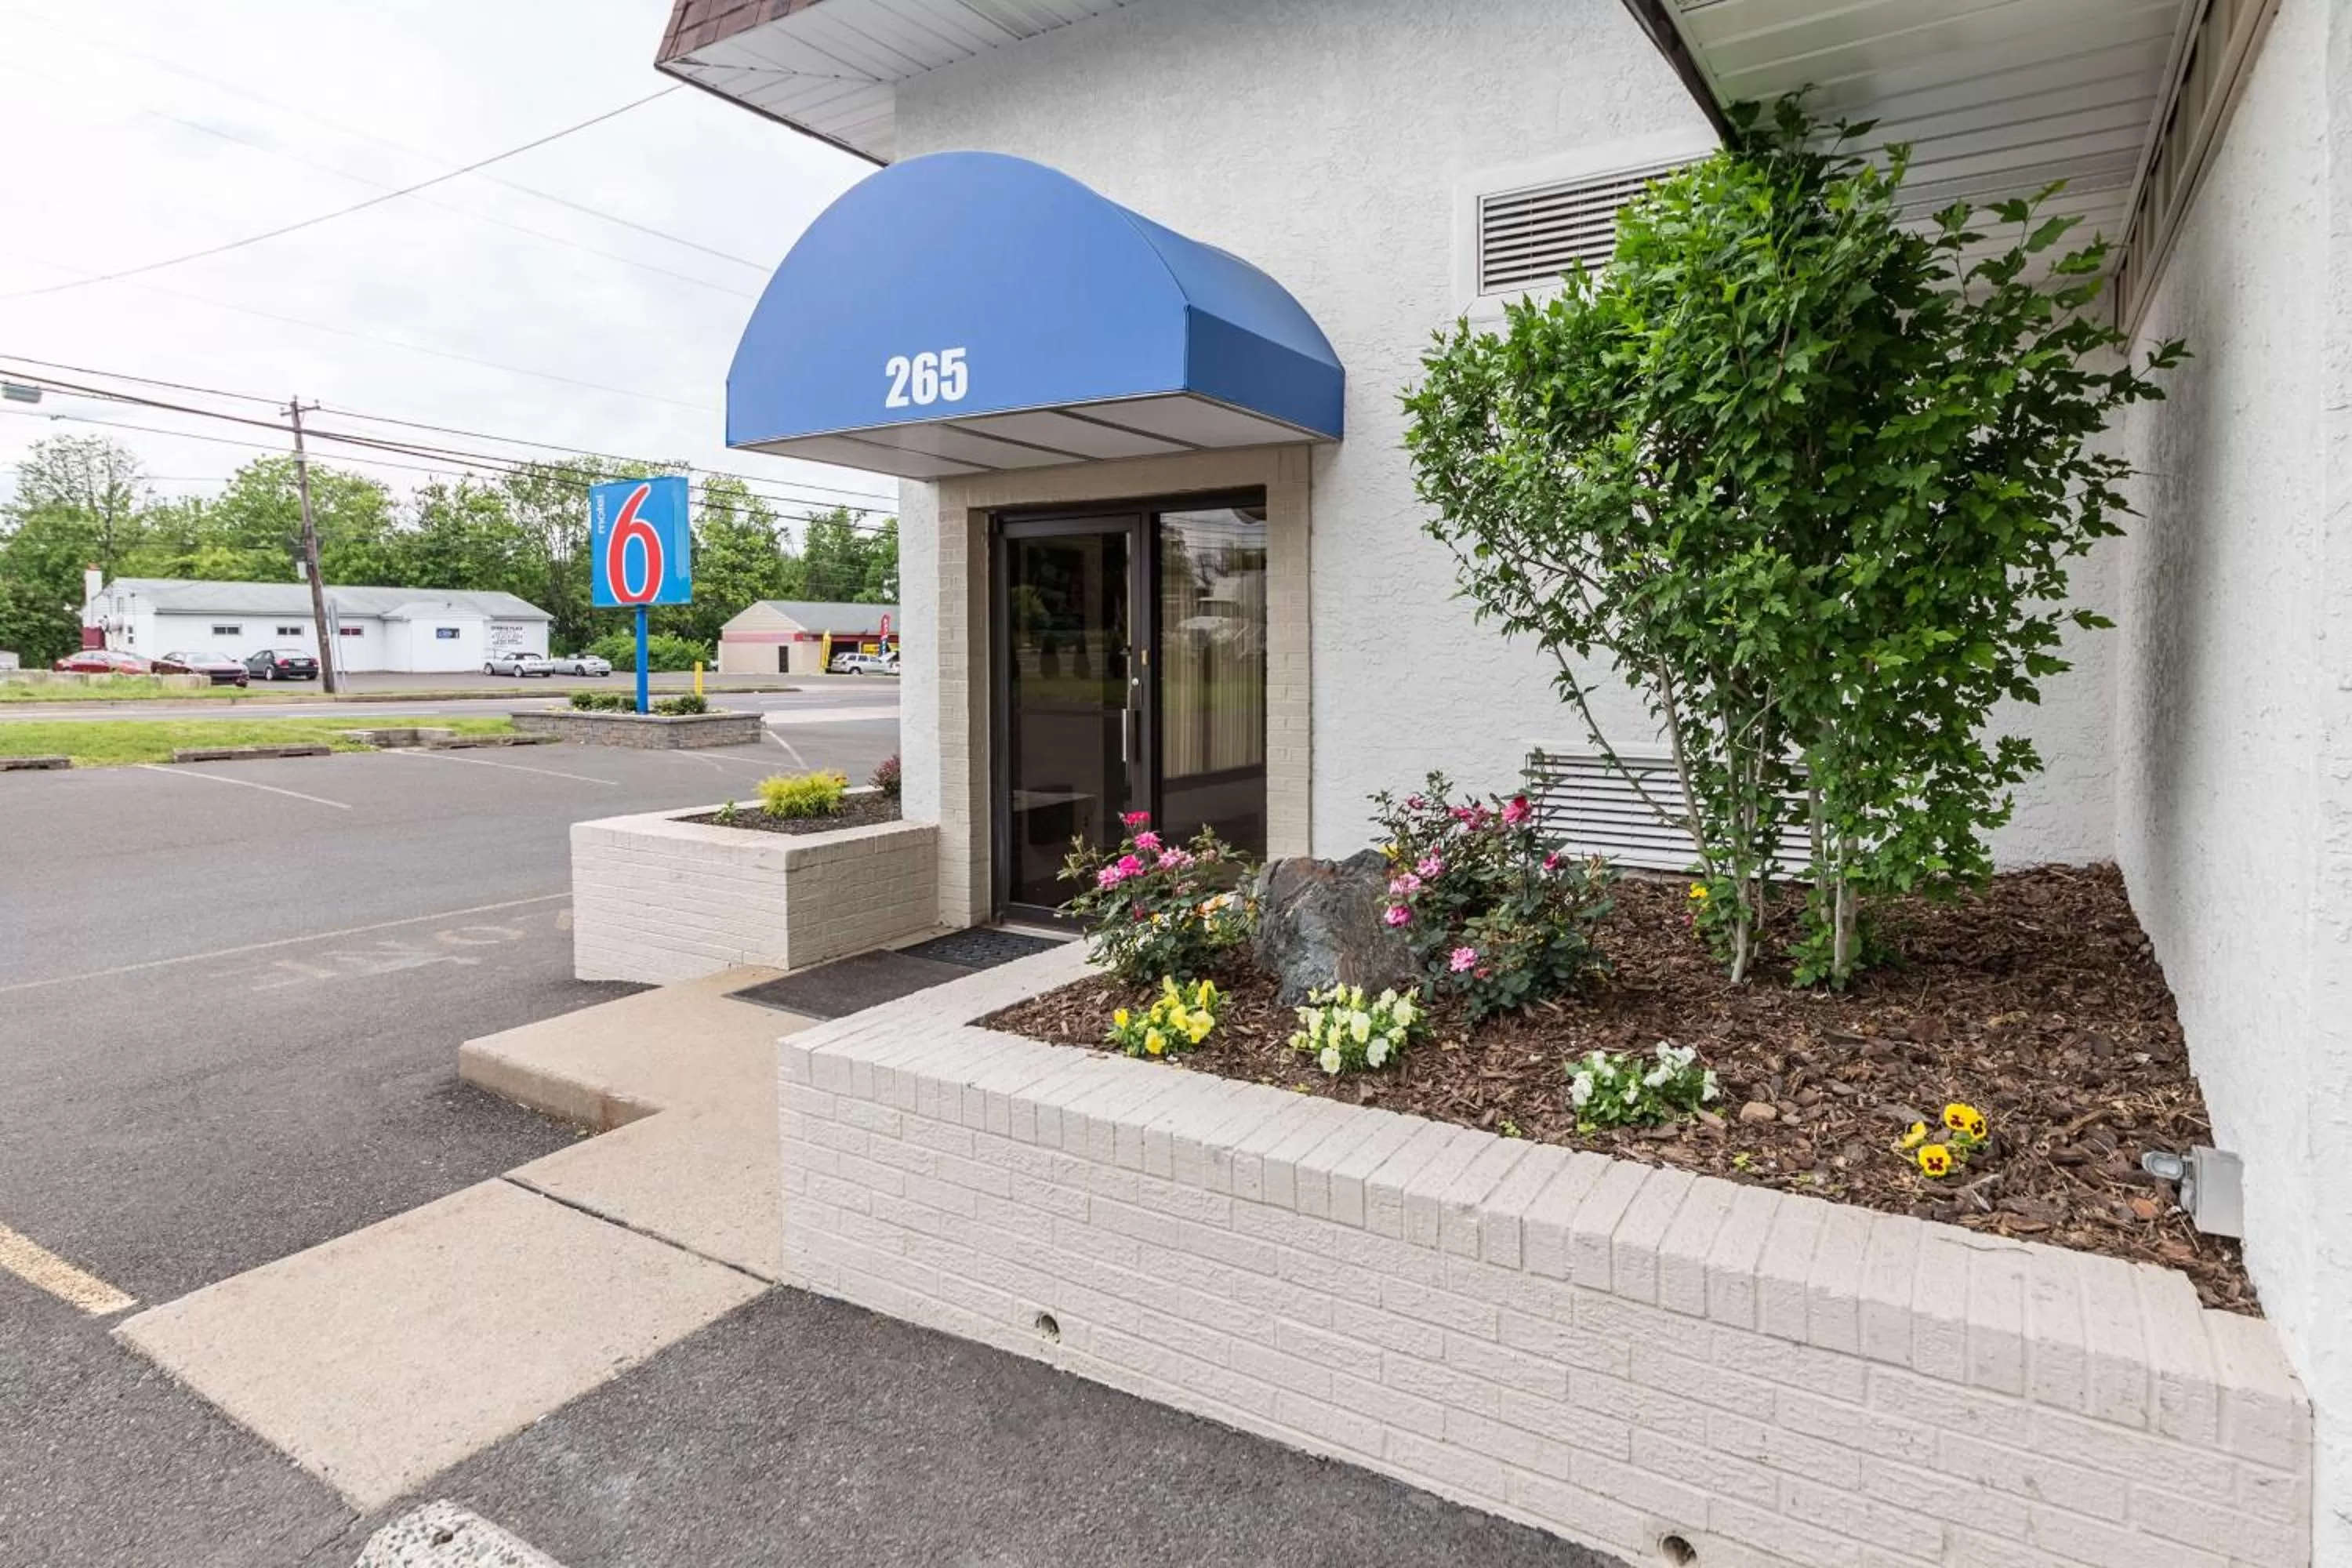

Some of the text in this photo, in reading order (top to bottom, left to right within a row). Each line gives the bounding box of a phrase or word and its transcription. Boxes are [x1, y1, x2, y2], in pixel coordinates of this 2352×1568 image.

[885, 347, 967, 408] 265
[596, 495, 605, 535] motel
[606, 482, 664, 604] 6
